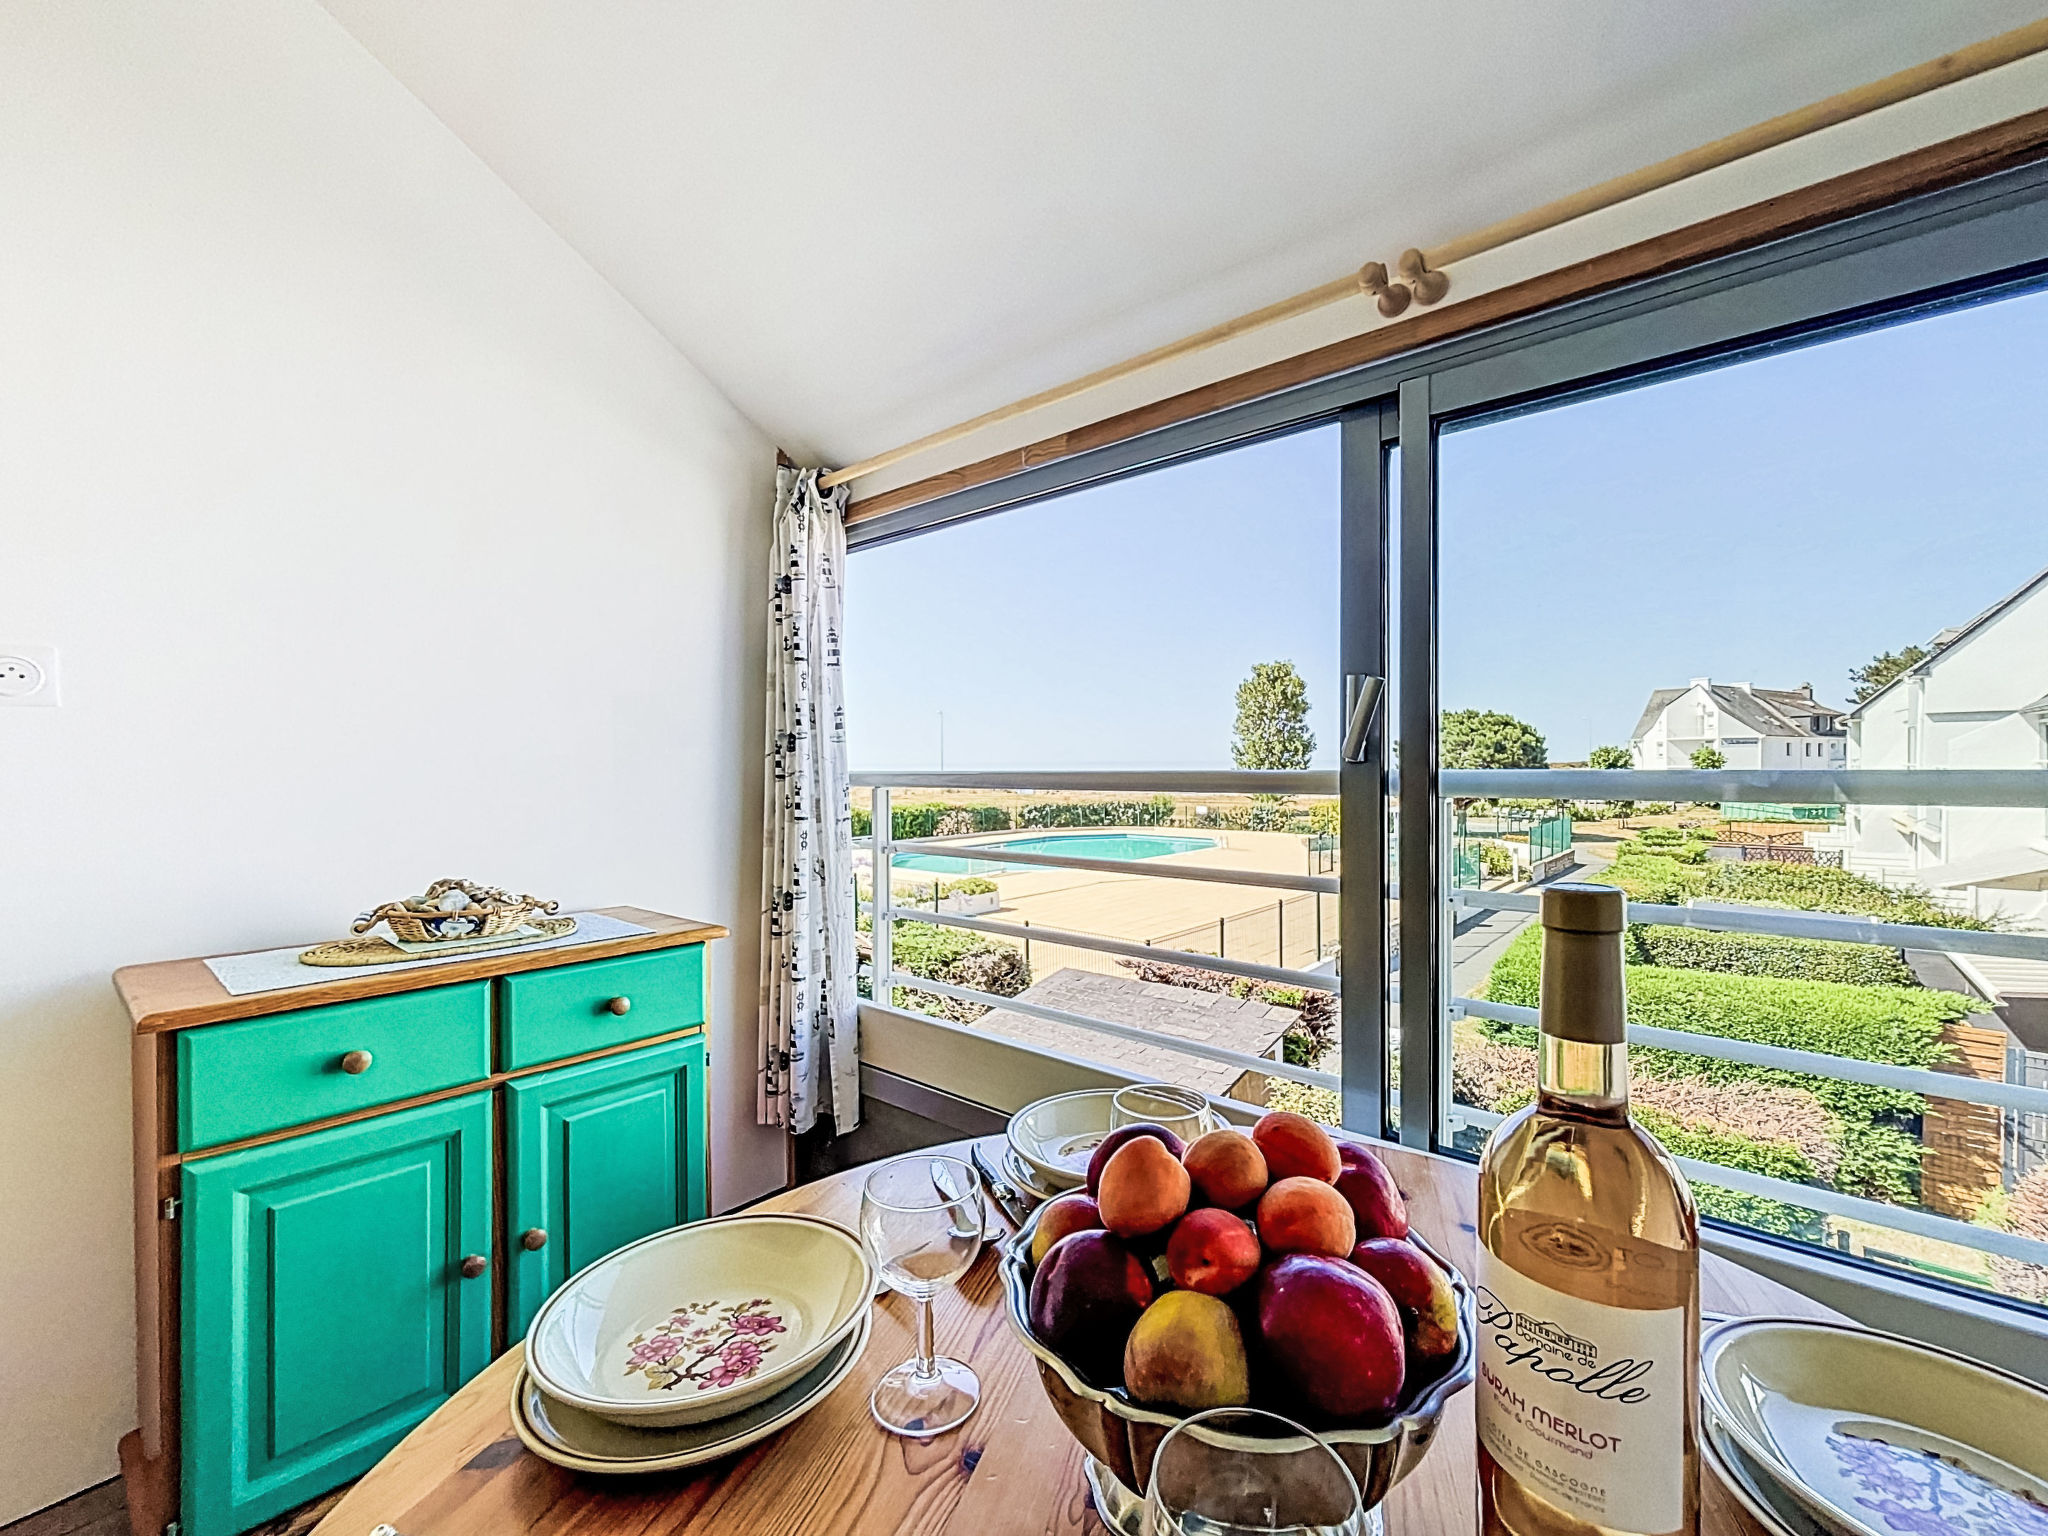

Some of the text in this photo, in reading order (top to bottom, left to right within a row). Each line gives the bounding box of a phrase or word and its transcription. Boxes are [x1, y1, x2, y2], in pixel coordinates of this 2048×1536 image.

[1476, 1285, 1654, 1404] Papolle
[1516, 1325, 1597, 1369] Domaine de
[1481, 1361, 1525, 1412] SYRAH
[1532, 1405, 1622, 1453] MERLOT
[1525, 1419, 1593, 1460] Gourmand
